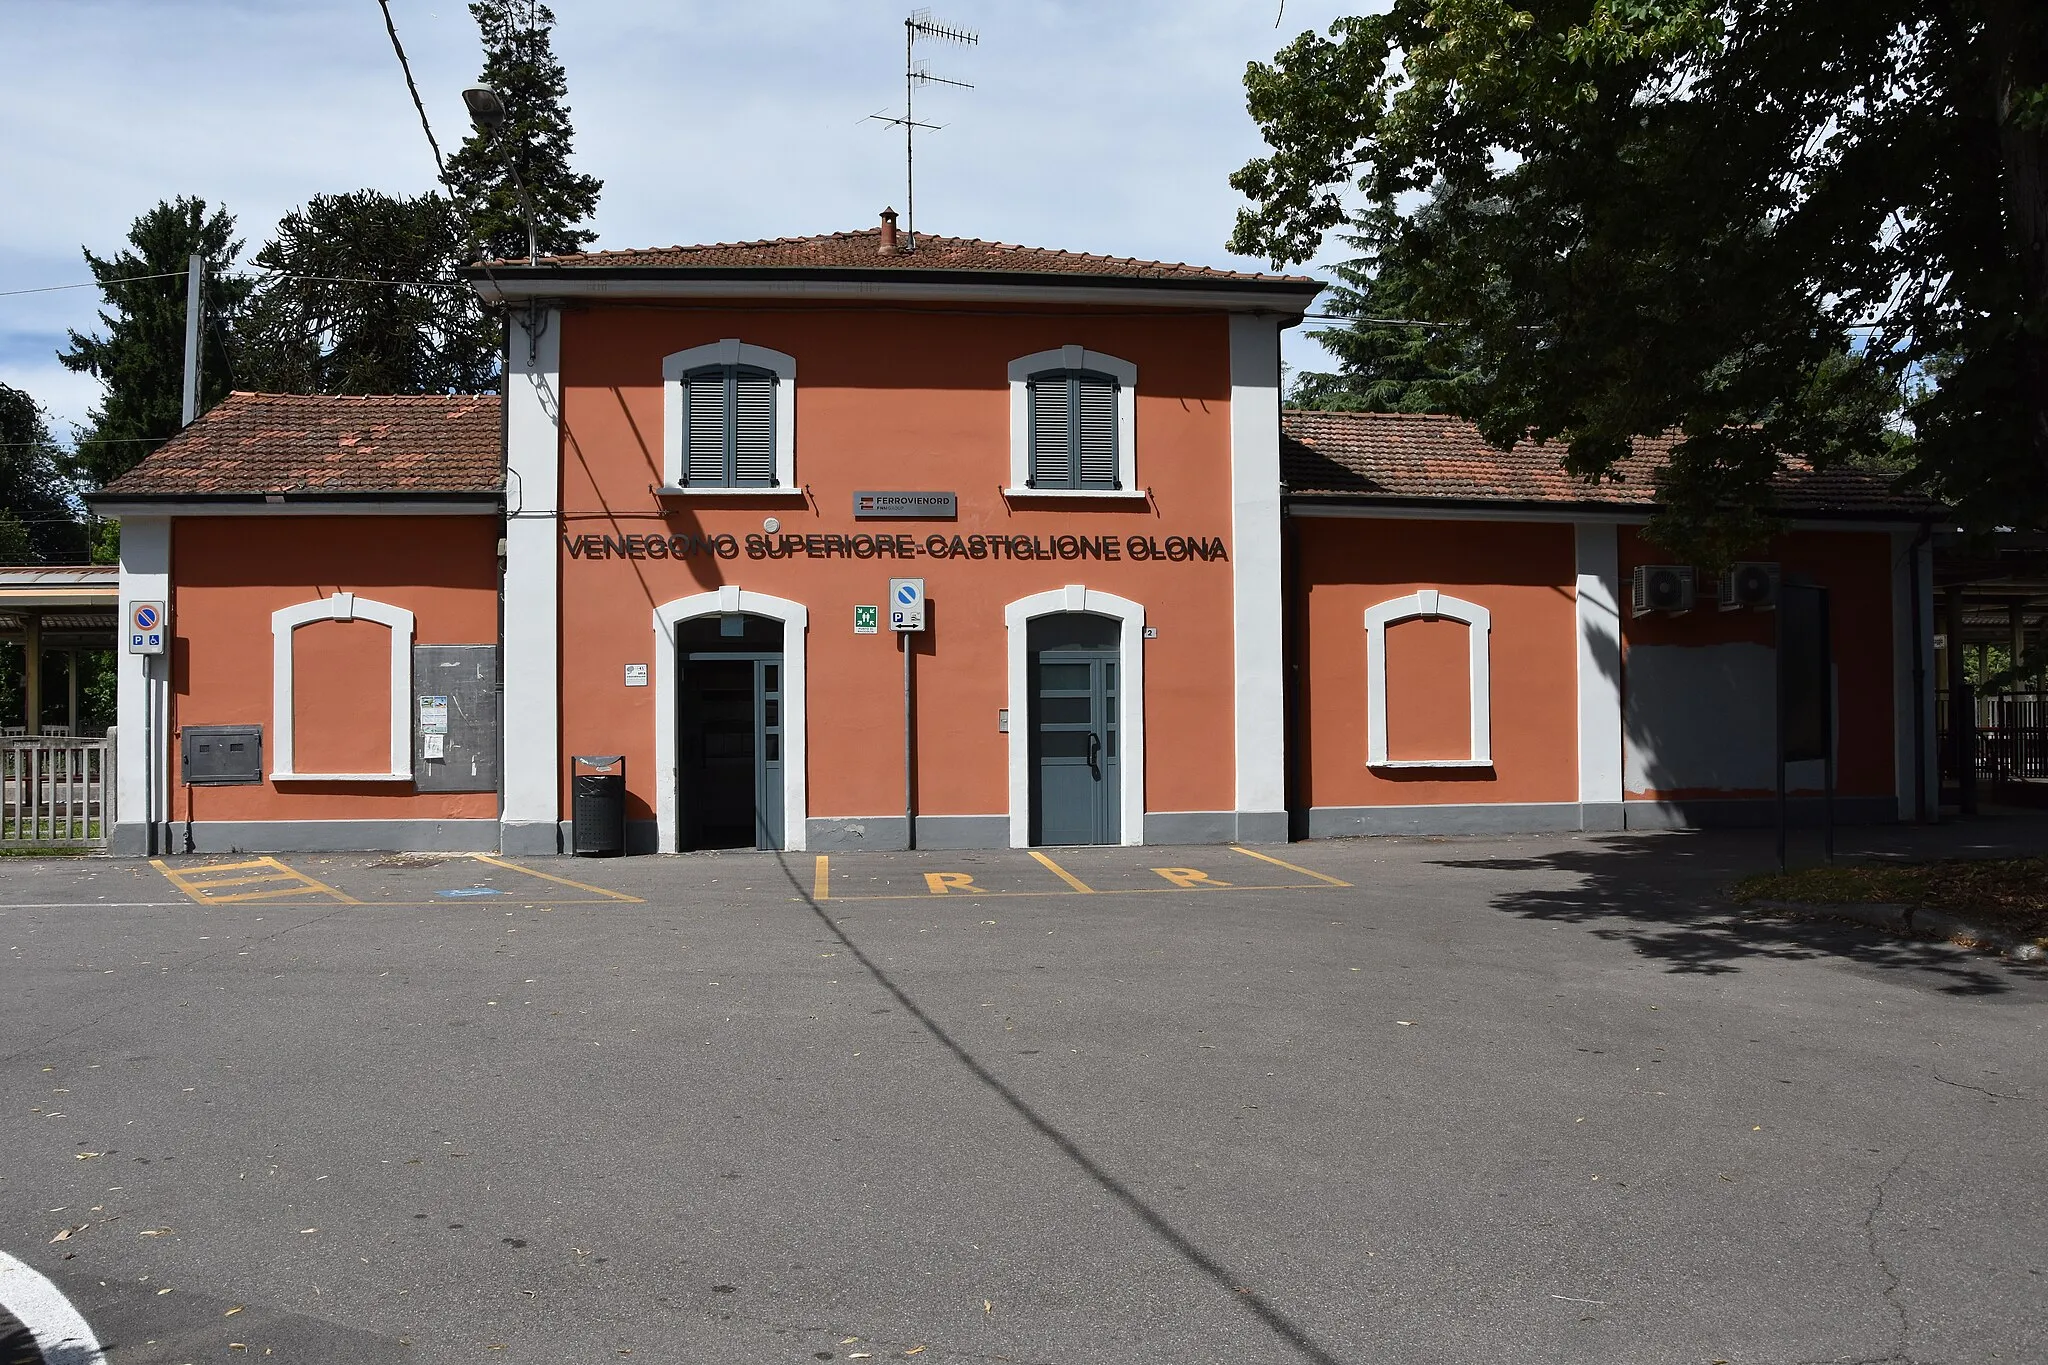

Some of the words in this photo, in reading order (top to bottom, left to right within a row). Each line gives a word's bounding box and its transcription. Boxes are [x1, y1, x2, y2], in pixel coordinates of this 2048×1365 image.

[876, 497, 950, 505] FERROVIENORD
[562, 533, 739, 558] VENEGONO
[745, 533, 1121, 560] SUPERIORE-CASTIGLIONE
[1127, 535, 1229, 561] OLONA
[894, 613, 902, 622] P
[135, 636, 142, 645] P
[924, 872, 989, 894] R
[1150, 868, 1233, 888] R
